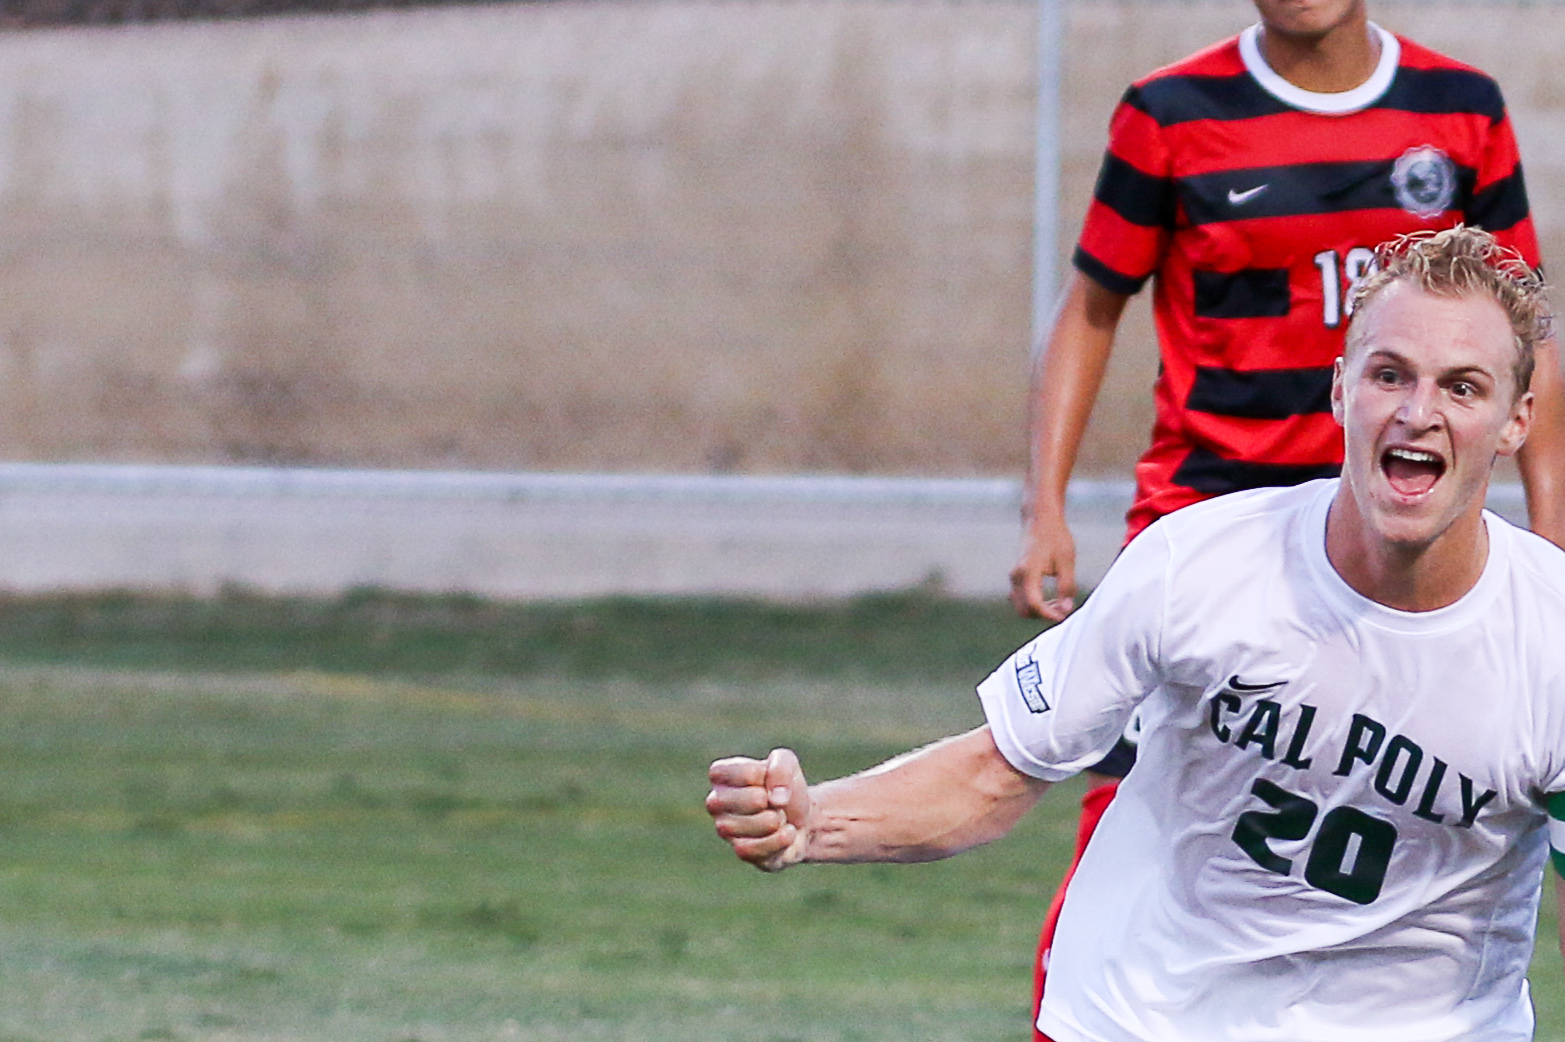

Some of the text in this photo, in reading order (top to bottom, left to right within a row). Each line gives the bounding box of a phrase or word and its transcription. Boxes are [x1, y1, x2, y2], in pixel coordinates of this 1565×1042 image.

[1210, 693, 1498, 829] CAL POLY
[1231, 777, 1398, 905] 20
